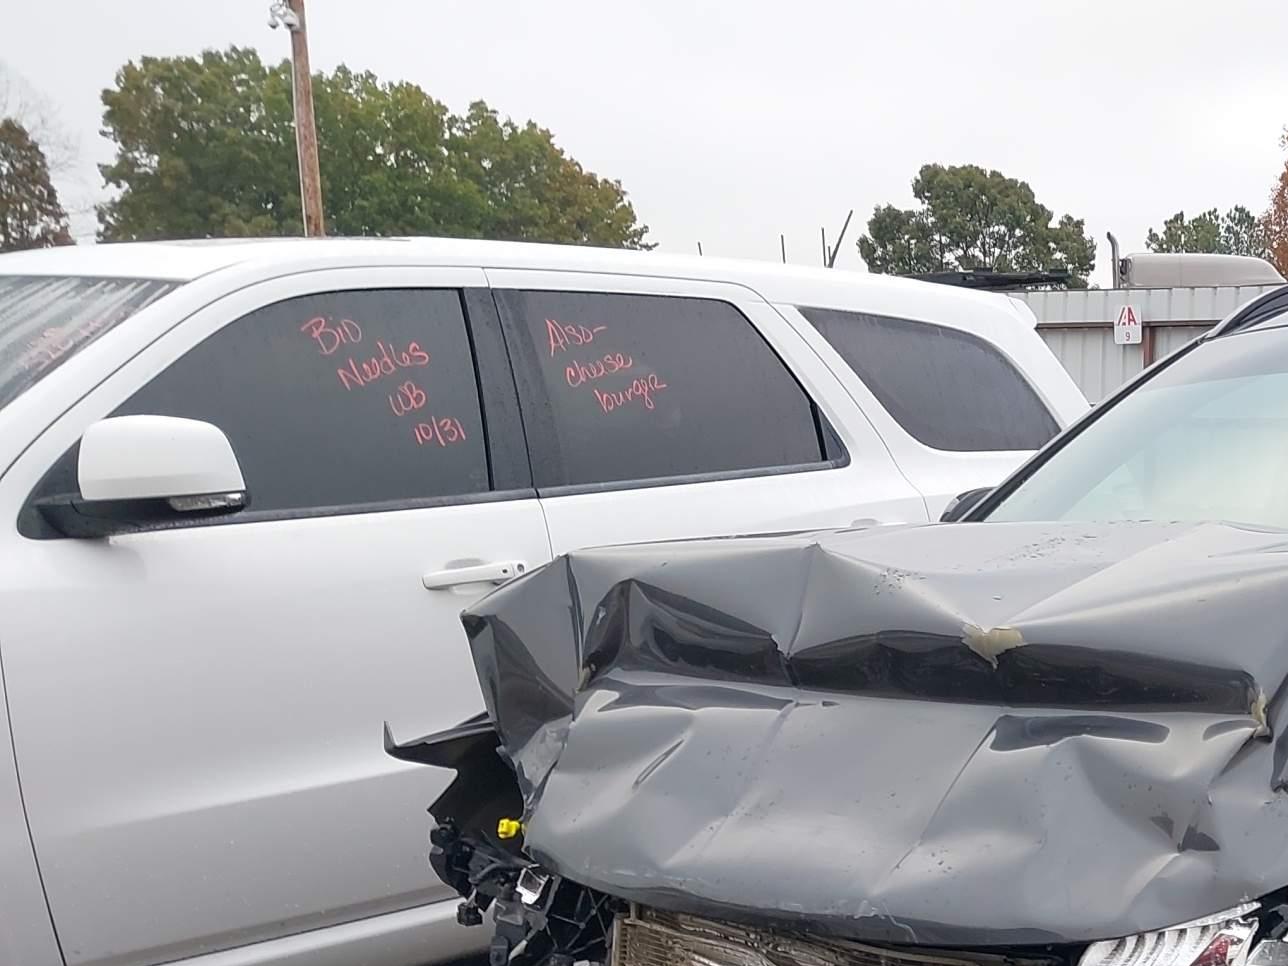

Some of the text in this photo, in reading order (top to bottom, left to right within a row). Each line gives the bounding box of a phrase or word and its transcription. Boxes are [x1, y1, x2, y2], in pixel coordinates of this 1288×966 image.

[1124, 331, 1131, 342] 9
[336, 341, 430, 392] Needles
[414, 415, 467, 447] 10/31
